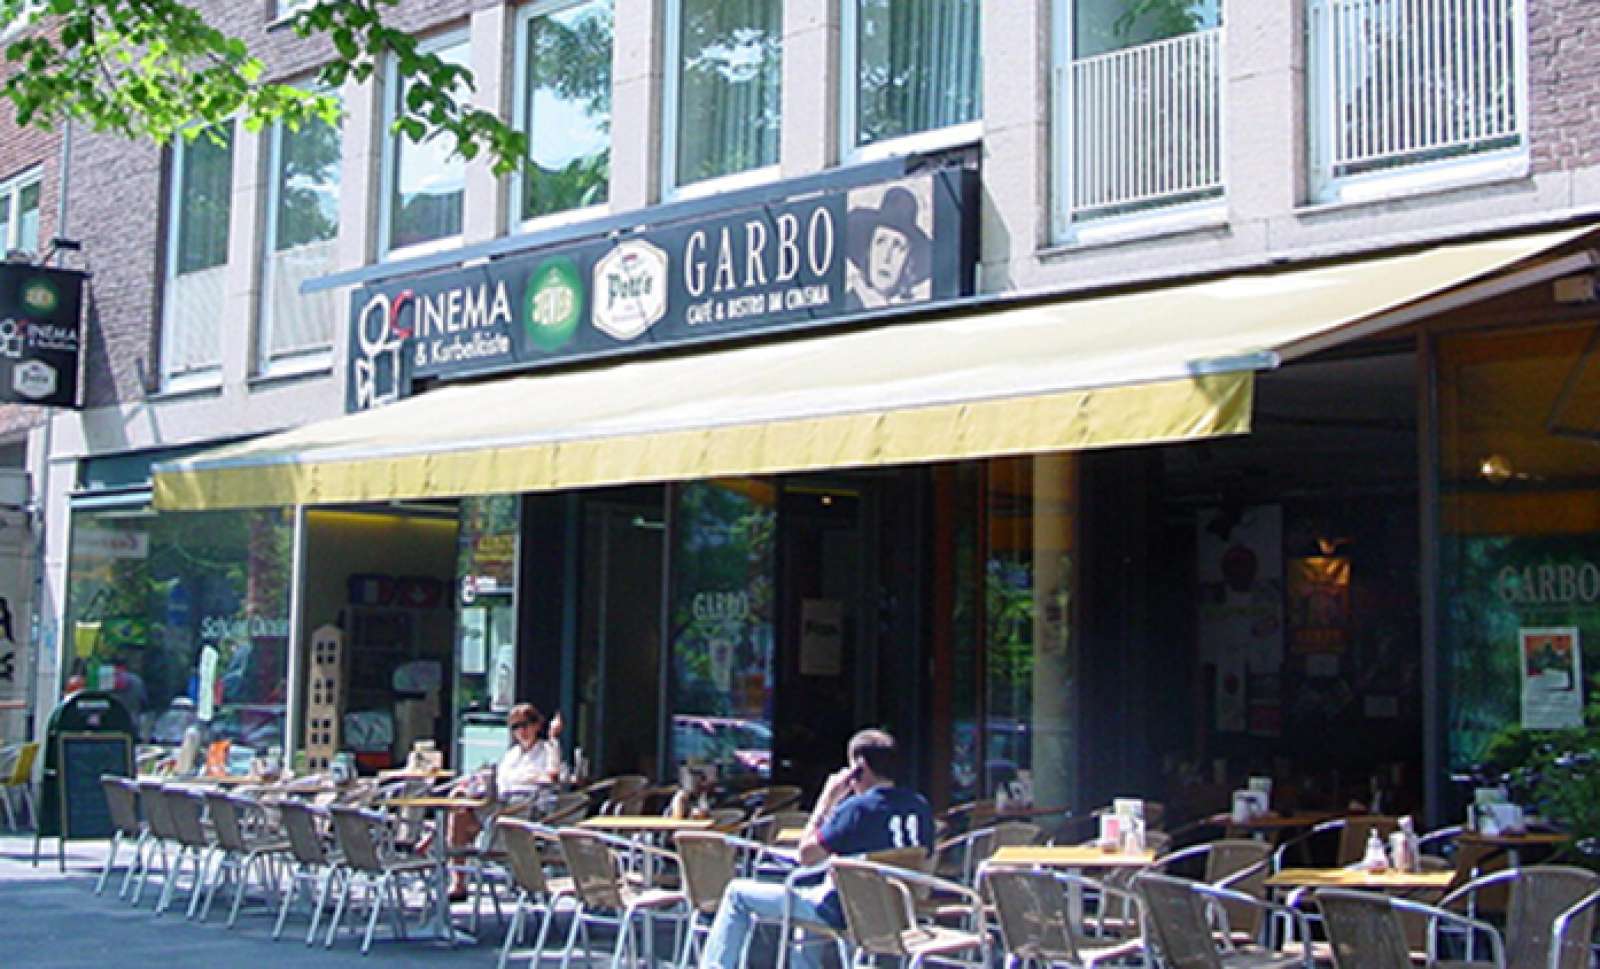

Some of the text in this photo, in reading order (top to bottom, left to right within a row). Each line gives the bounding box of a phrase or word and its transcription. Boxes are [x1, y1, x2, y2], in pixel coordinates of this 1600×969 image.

[684, 206, 834, 297] GARBO
[389, 279, 512, 339] CINEMA
[414, 341, 428, 366] &
[1499, 562, 1599, 602] GARBO
[888, 814, 923, 848] 11
